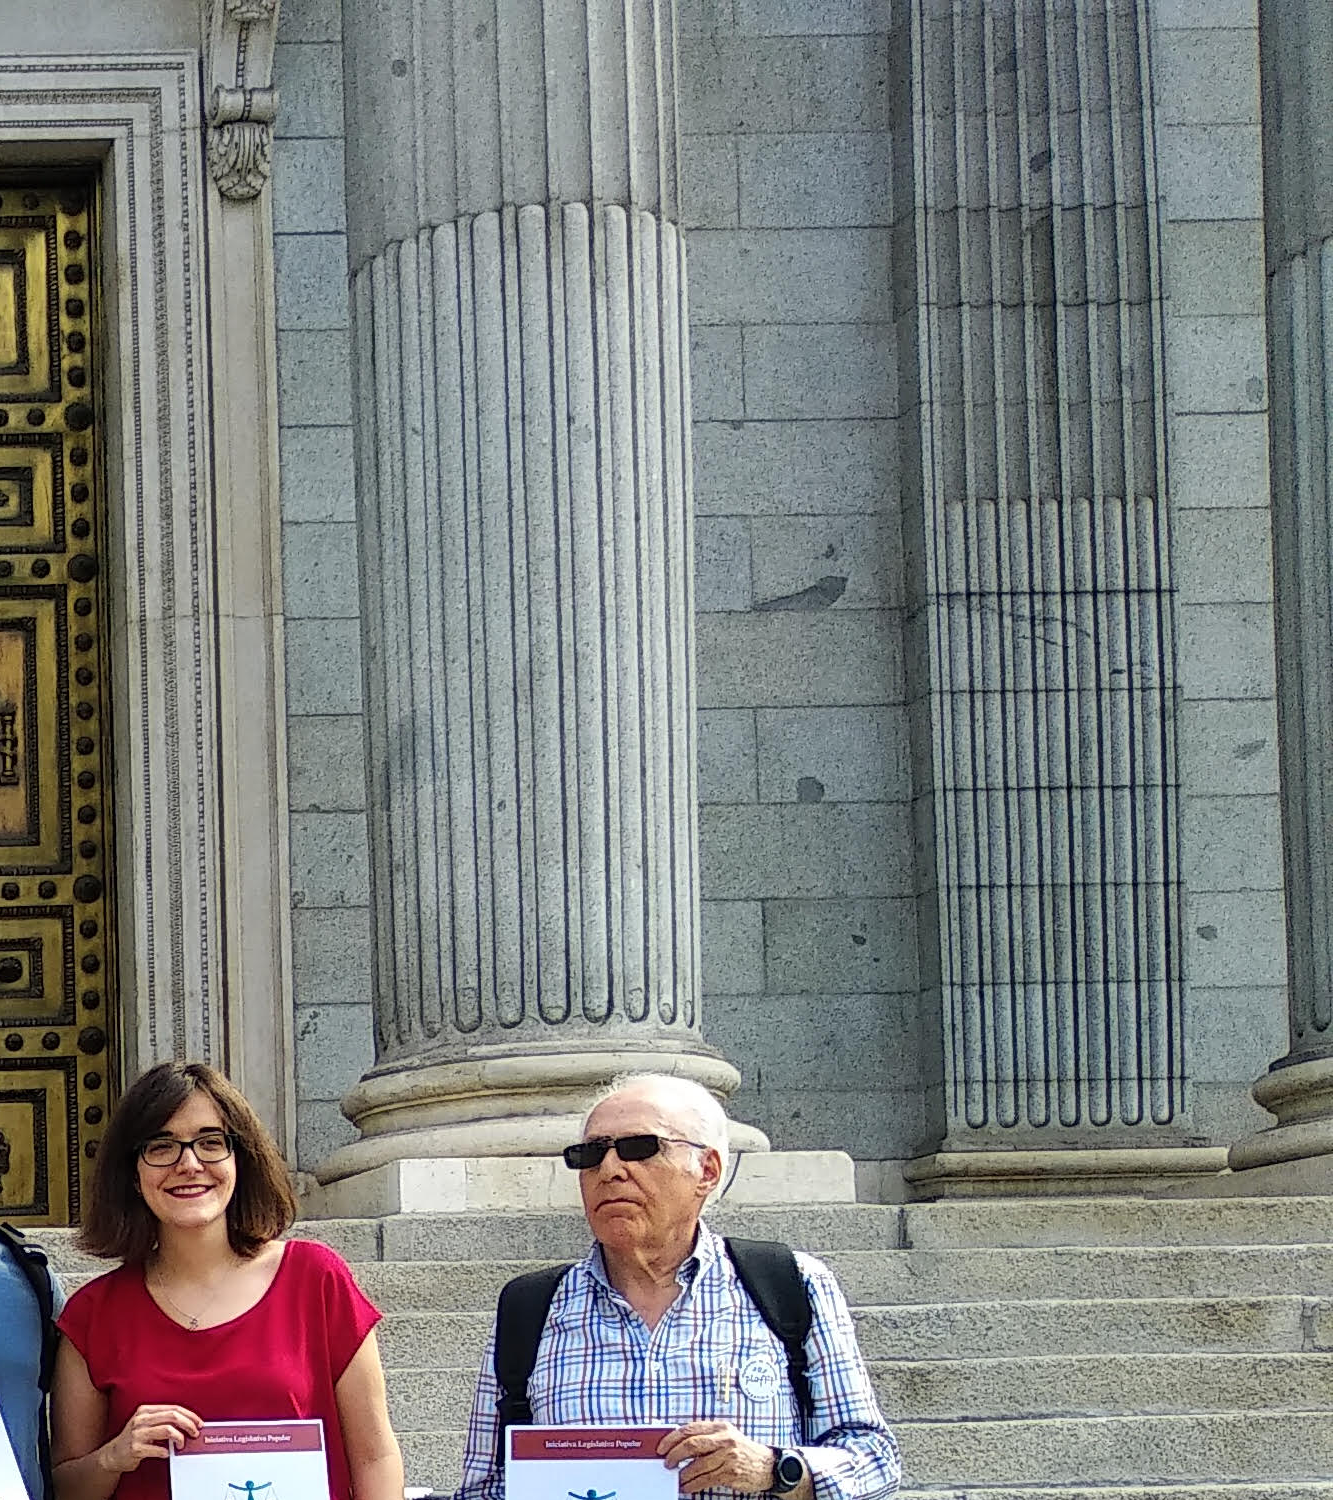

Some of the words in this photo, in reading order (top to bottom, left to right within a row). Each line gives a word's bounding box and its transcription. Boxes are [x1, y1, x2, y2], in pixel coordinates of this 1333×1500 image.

[545, 1440, 577, 1448] Iniciativa
[578, 1440, 615, 1449] Legislativa
[615, 1440, 641, 1448] Popular
